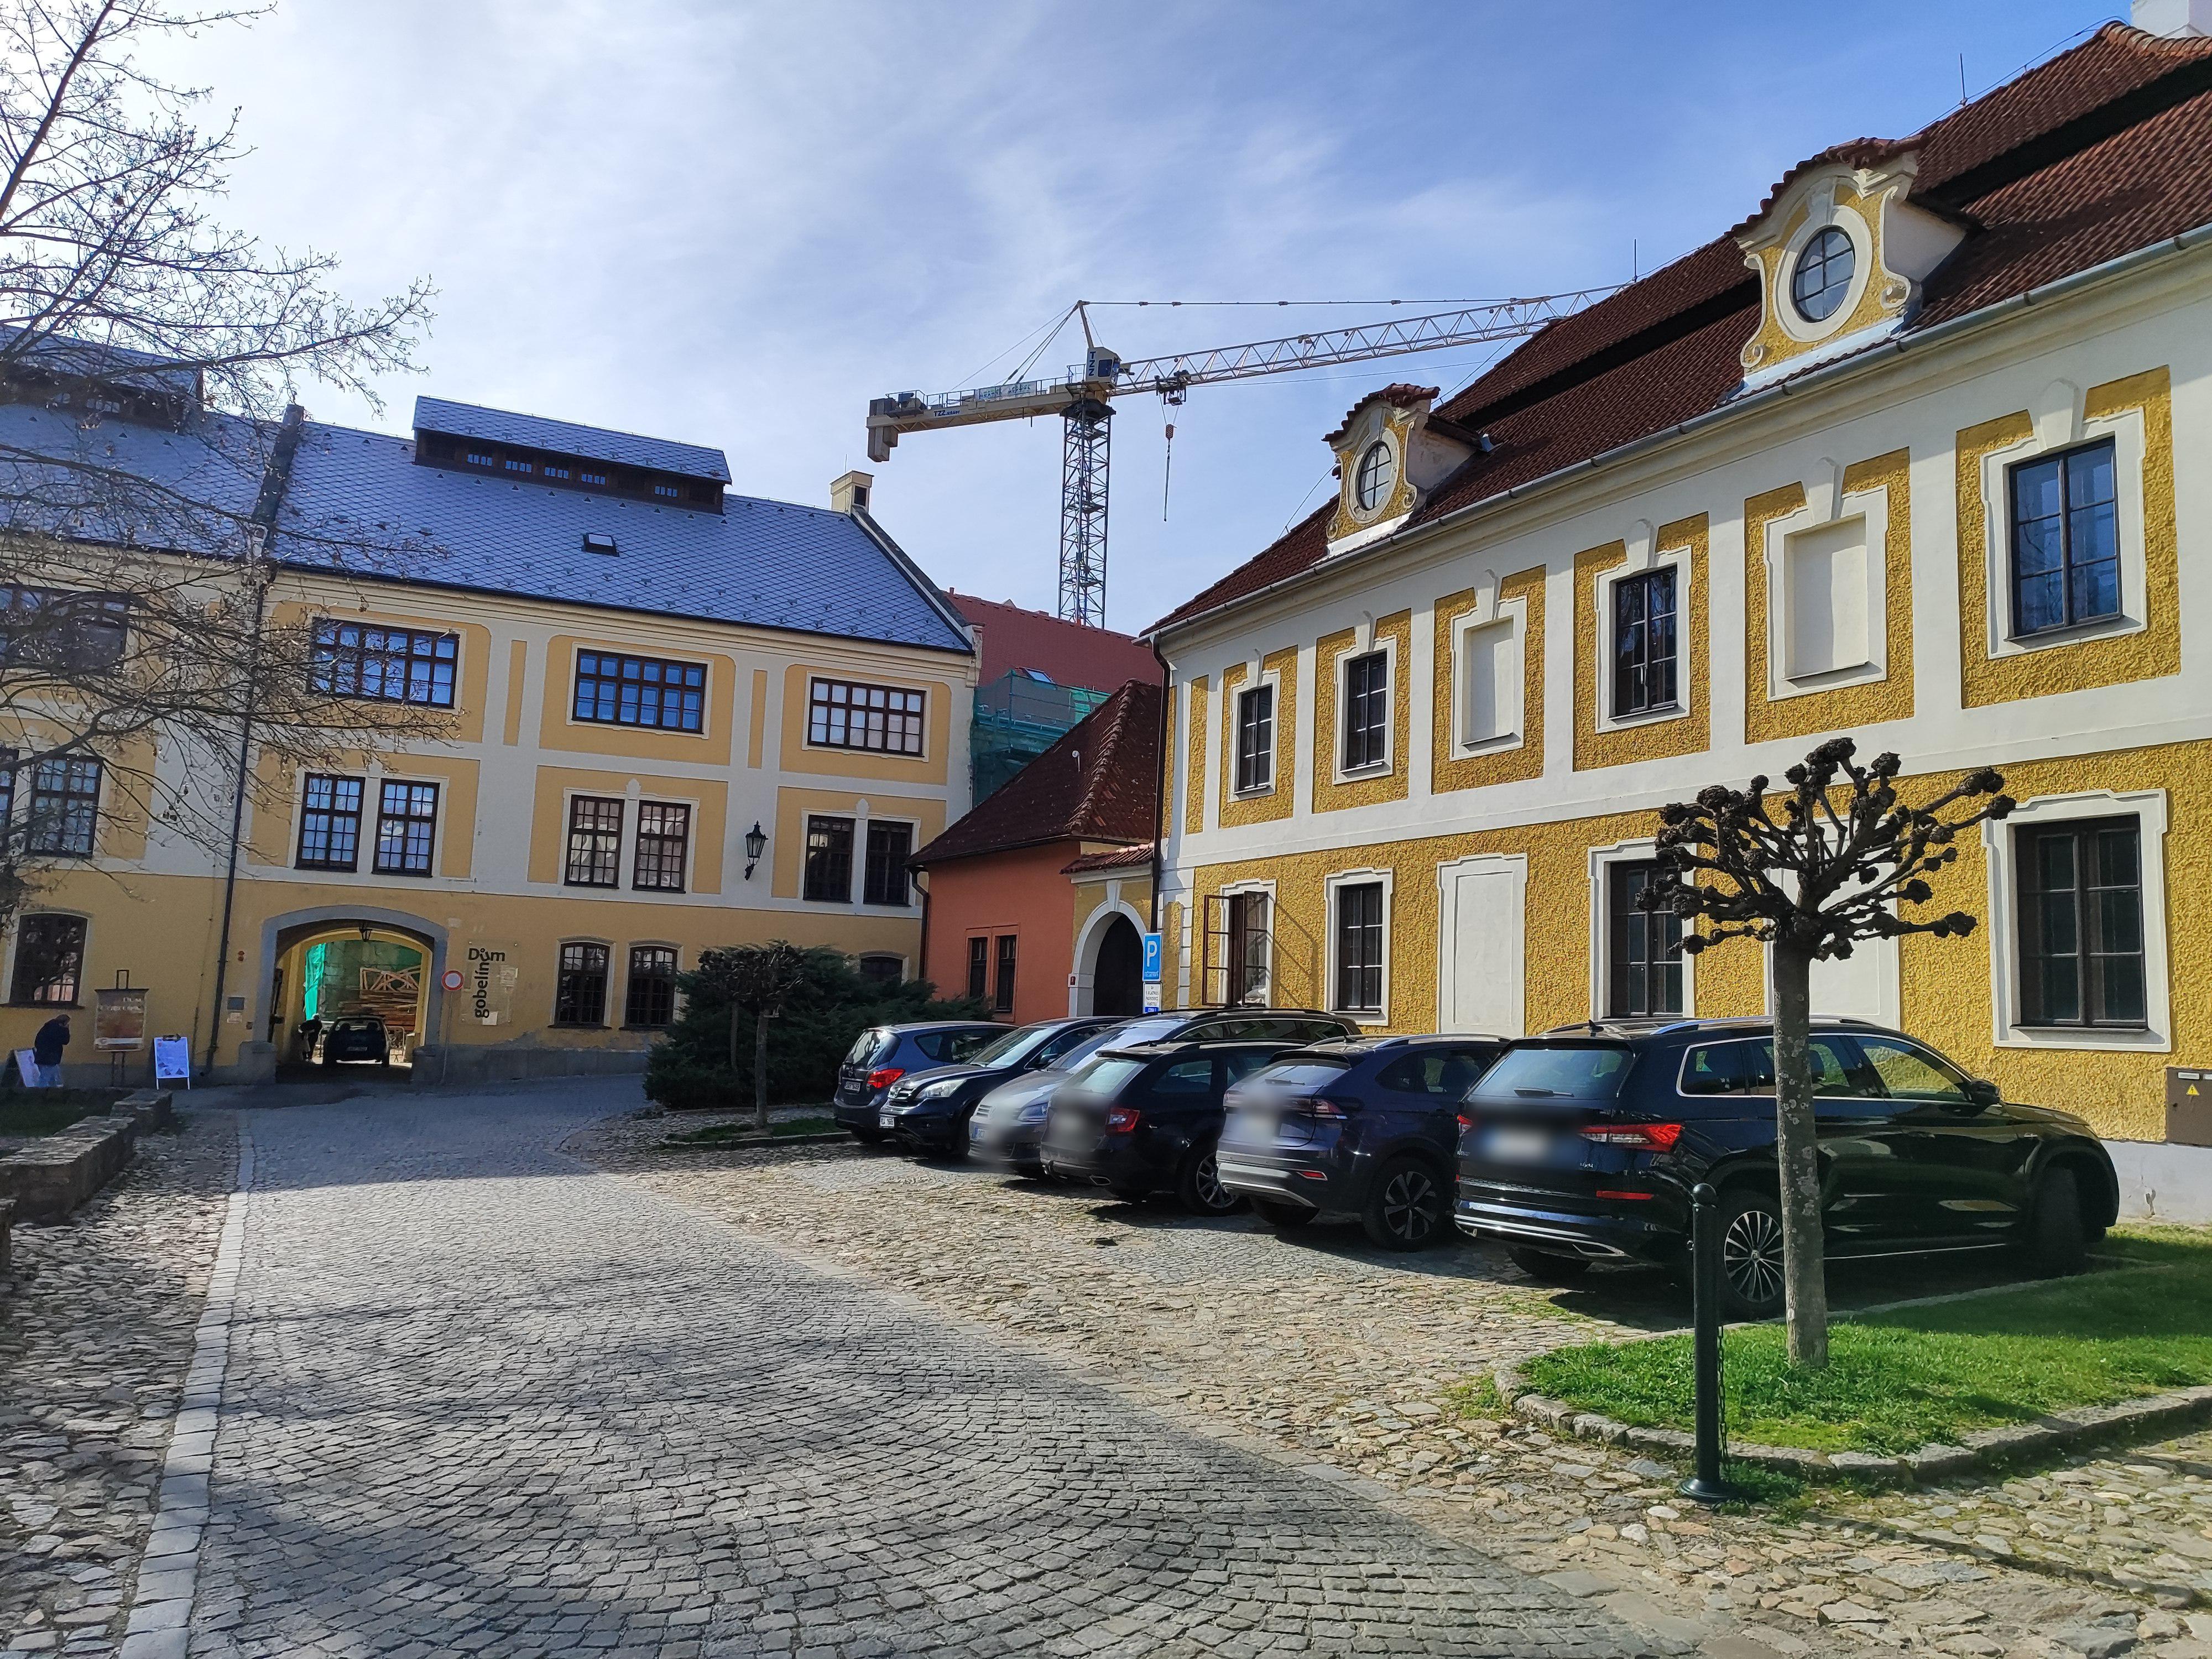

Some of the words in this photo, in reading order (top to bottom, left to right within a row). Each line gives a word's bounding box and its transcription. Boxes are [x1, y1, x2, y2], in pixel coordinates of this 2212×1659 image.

[1088, 351, 1097, 377] TZZ
[468, 948, 505, 962] Dům
[1146, 941, 1157, 967] P
